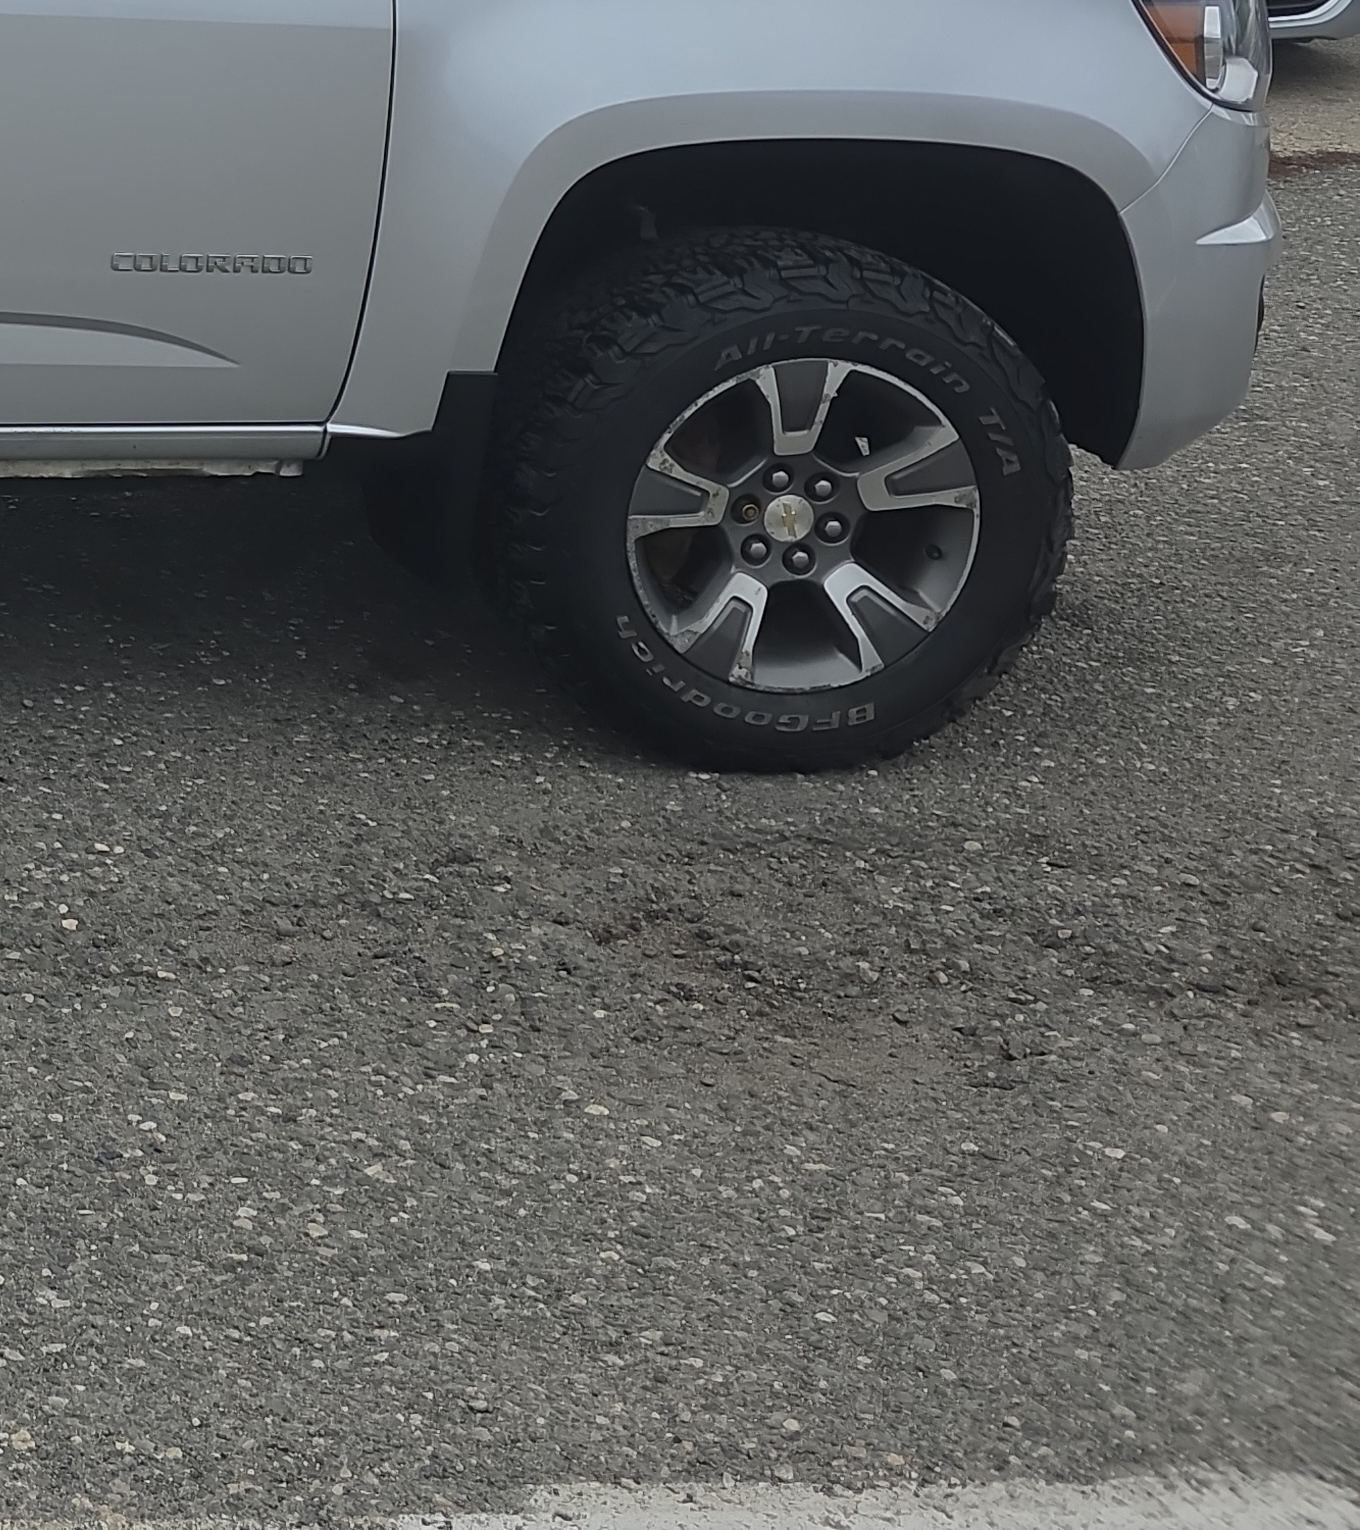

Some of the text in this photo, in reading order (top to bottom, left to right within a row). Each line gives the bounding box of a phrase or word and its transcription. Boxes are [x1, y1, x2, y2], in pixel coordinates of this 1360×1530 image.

[111, 252, 314, 274] COLORADO
[713, 324, 971, 395] All-Terrain
[612, 613, 876, 733] BFGoodrich
